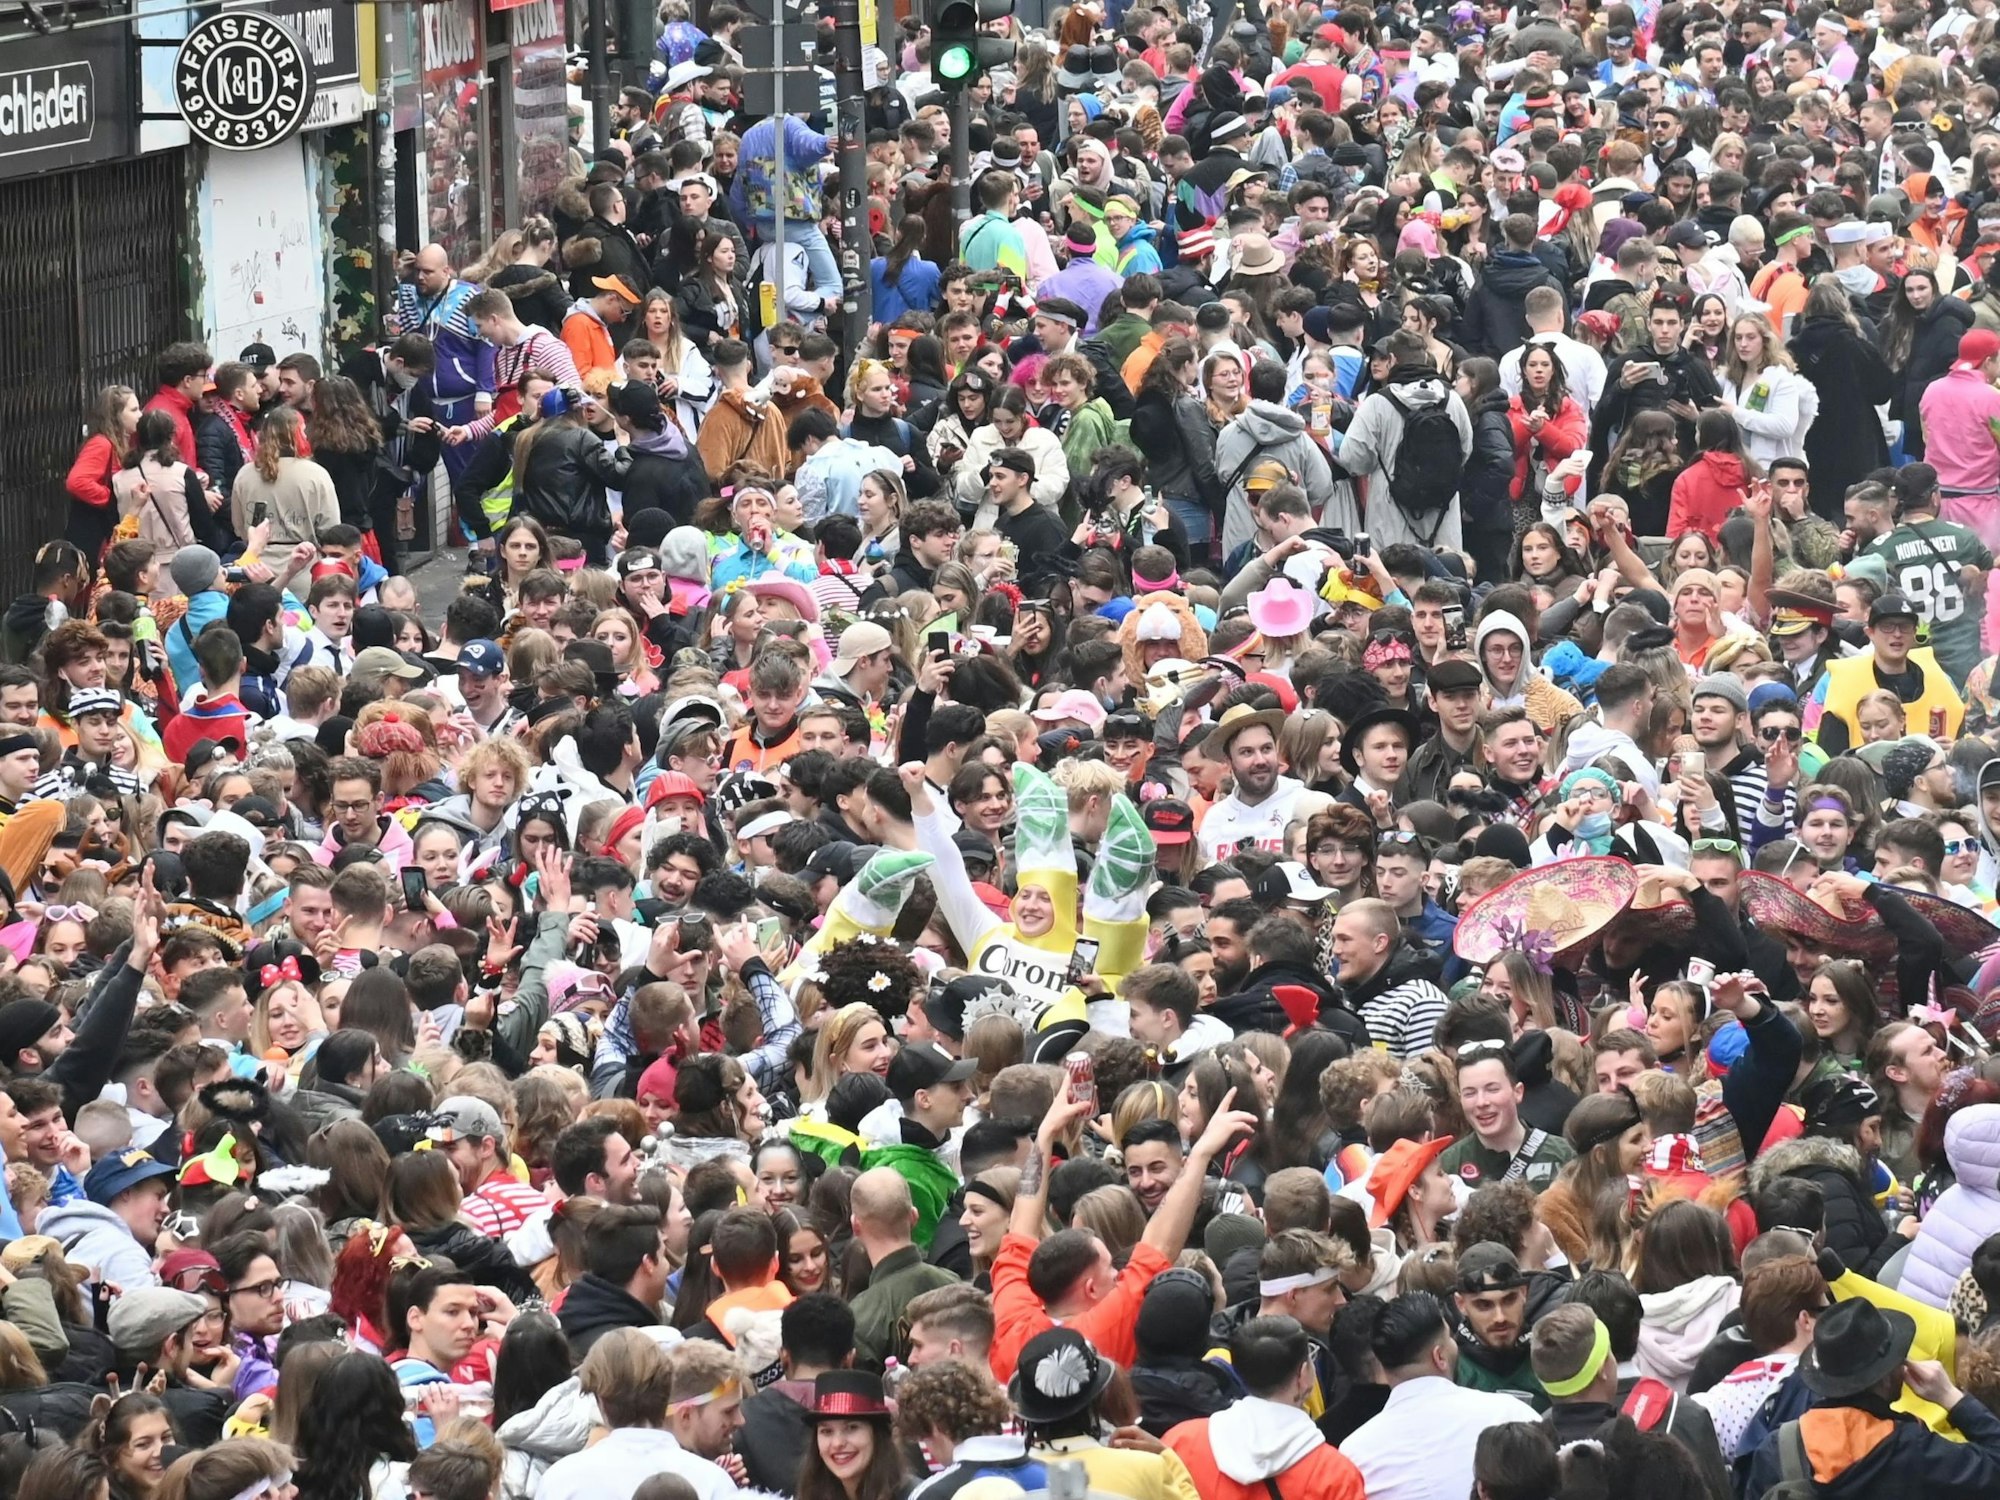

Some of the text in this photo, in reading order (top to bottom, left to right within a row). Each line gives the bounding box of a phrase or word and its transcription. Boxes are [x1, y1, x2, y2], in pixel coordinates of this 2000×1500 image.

[182, 18, 295, 71] FRISEUR
[422, 1, 475, 72] KIOSK
[216, 57, 264, 105] K&B
[184, 94, 297, 144] 9383320
[979, 944, 1071, 994] Coron
